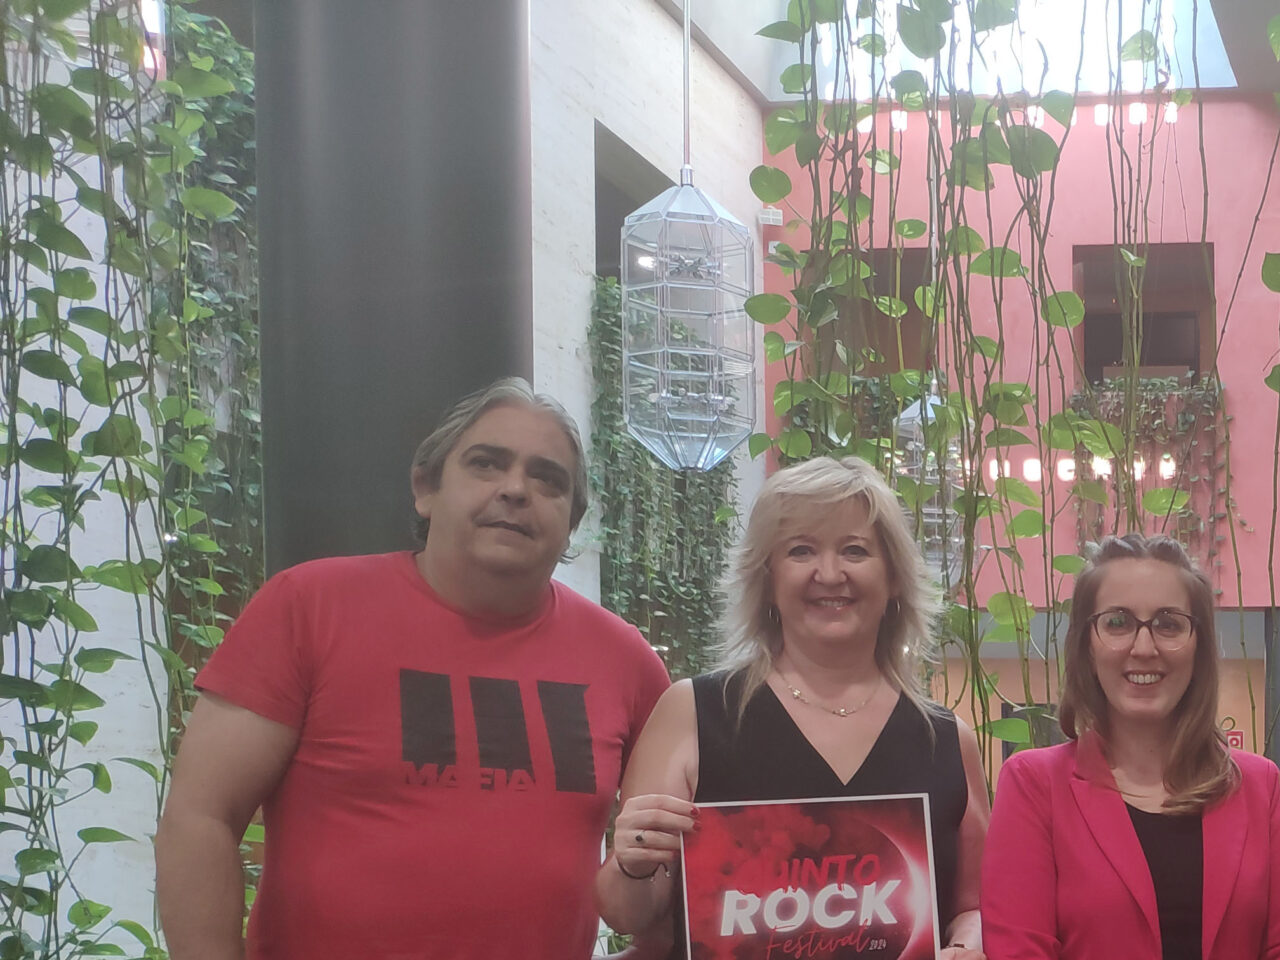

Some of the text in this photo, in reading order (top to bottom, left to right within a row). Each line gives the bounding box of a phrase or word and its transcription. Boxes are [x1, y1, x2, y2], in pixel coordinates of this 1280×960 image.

[400, 761, 537, 791] MAFIA
[720, 879, 902, 937] ROCK
[766, 918, 887, 960] Festival 2024
